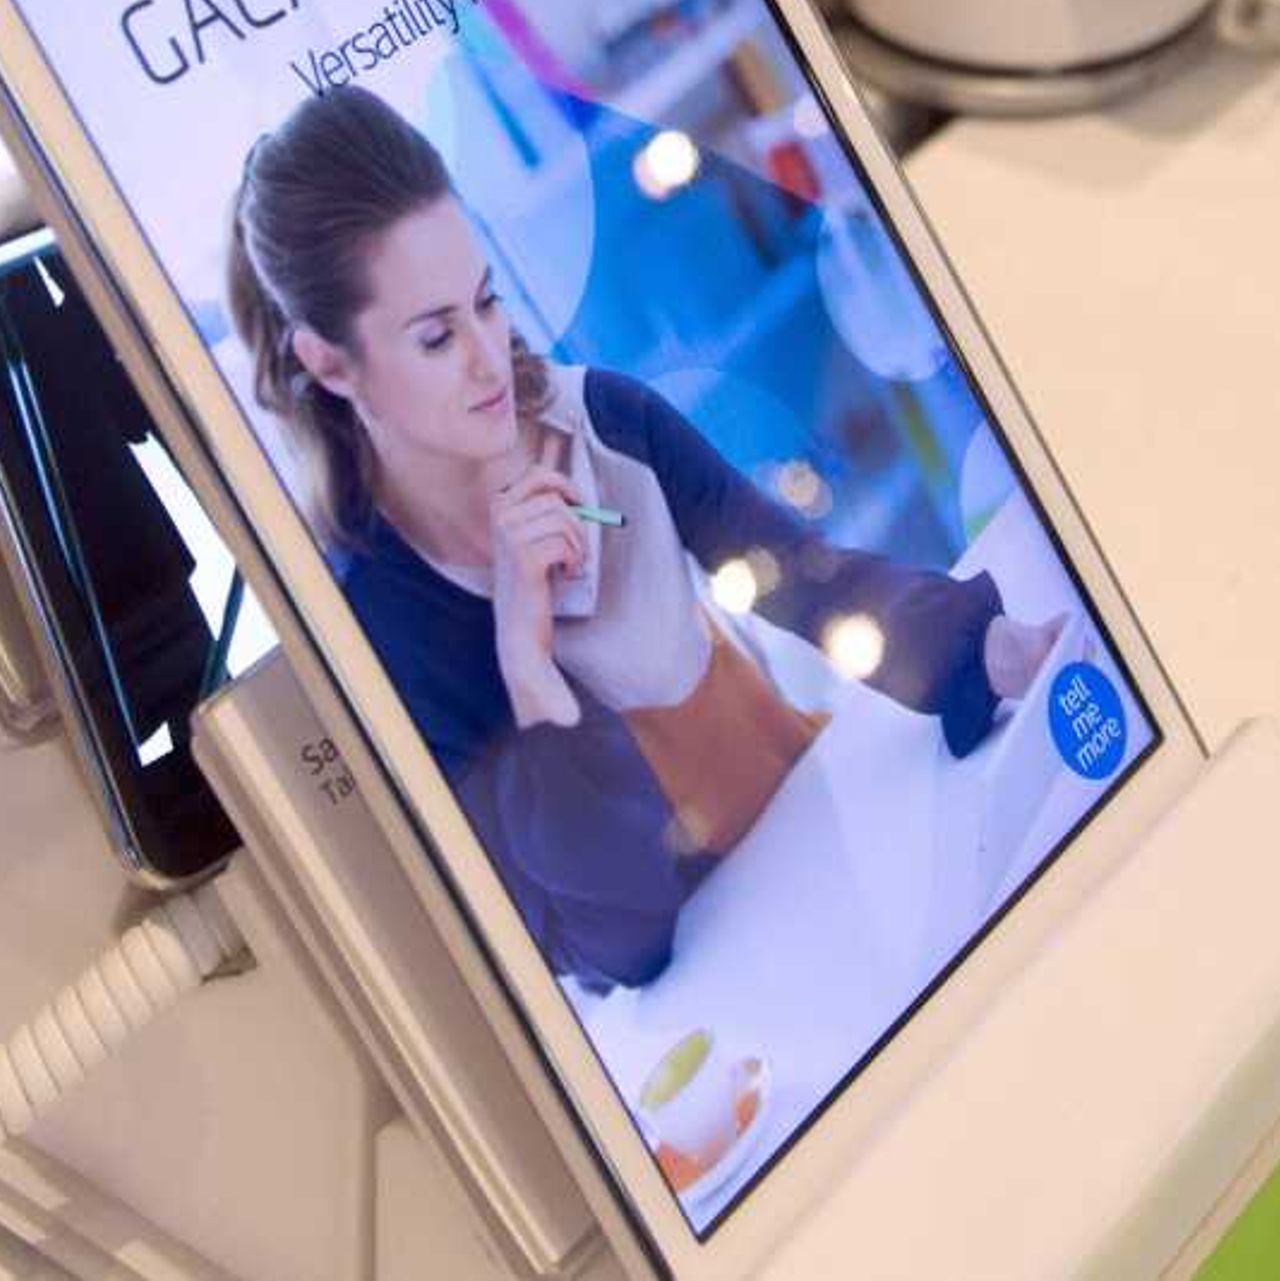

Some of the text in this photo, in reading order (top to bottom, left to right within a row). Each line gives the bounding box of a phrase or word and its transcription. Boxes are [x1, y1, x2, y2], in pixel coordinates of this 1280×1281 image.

[1059, 675, 1091, 716] tell
[1072, 704, 1102, 739] me
[1077, 718, 1121, 770] more
